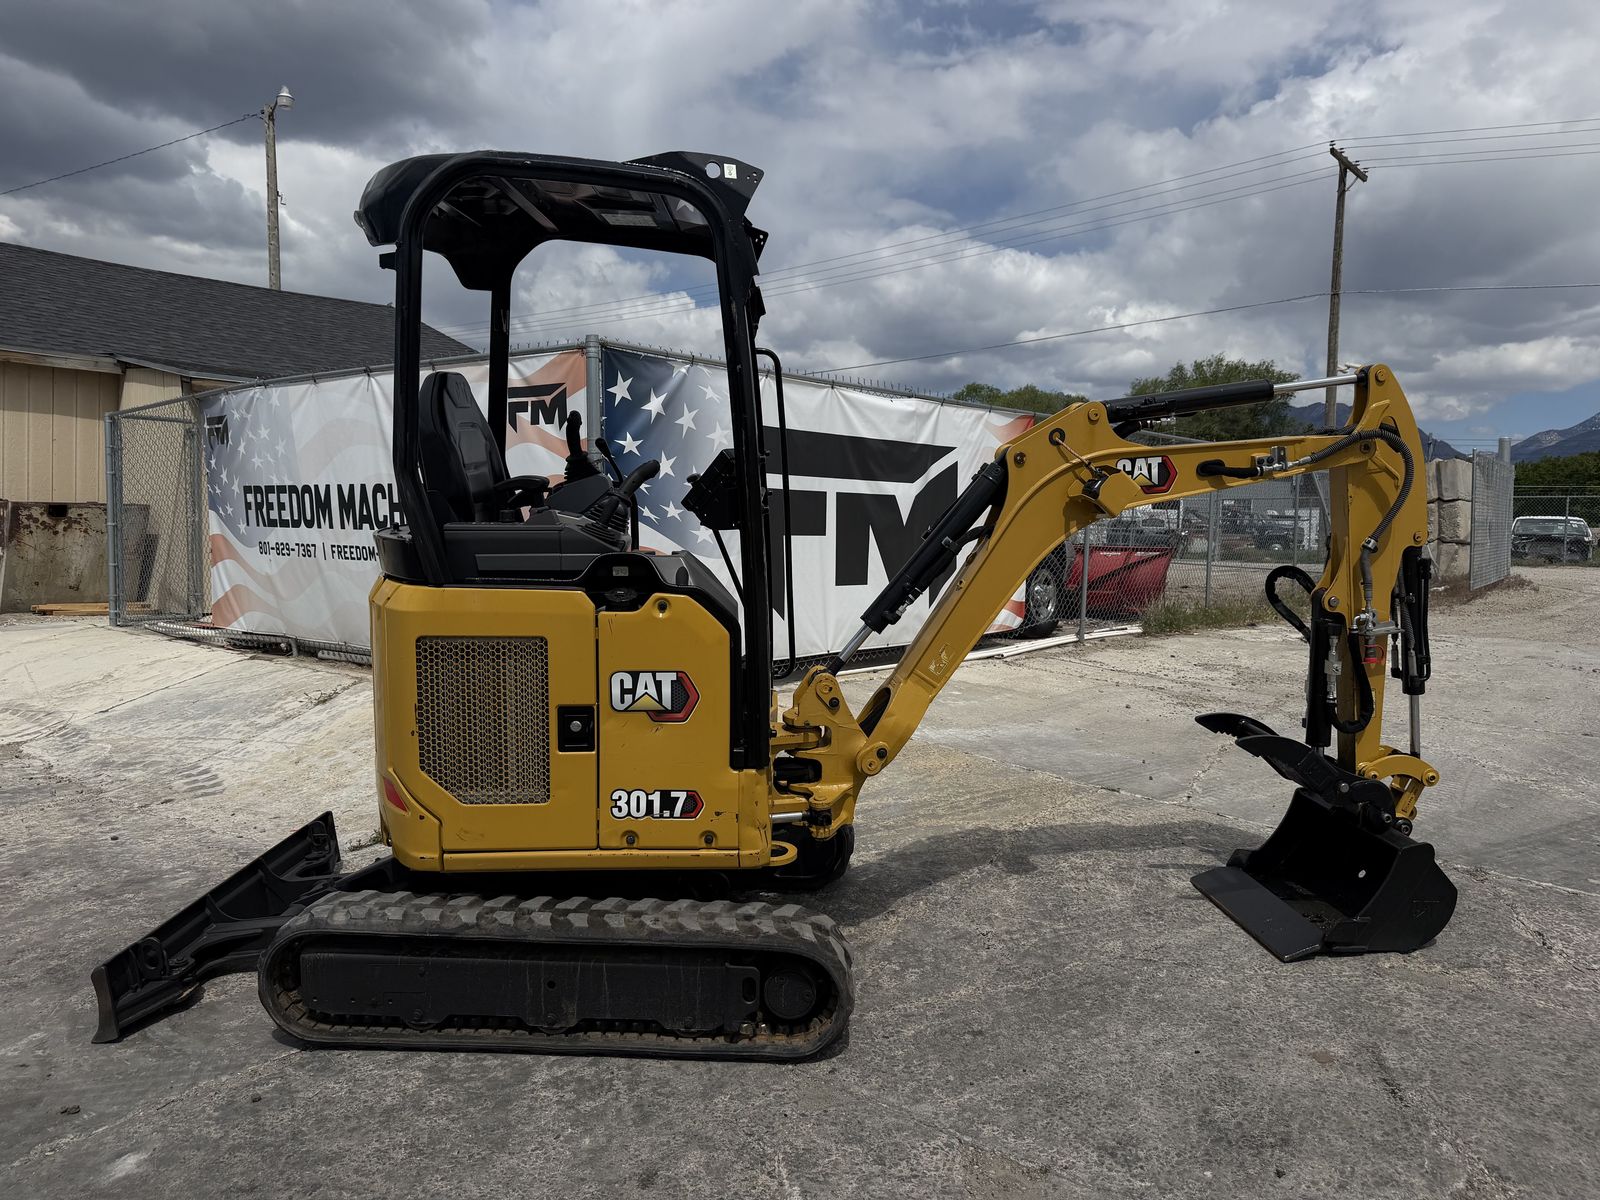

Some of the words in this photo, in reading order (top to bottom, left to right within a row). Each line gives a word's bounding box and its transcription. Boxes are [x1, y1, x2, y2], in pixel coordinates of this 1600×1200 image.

[507, 382, 567, 433] FM
[1117, 456, 1163, 485] CAT
[243, 484, 334, 529] FREEDOM
[259, 541, 317, 558] 801-829-7367
[611, 672, 677, 711] CAT
[611, 790, 687, 818] 301.7
